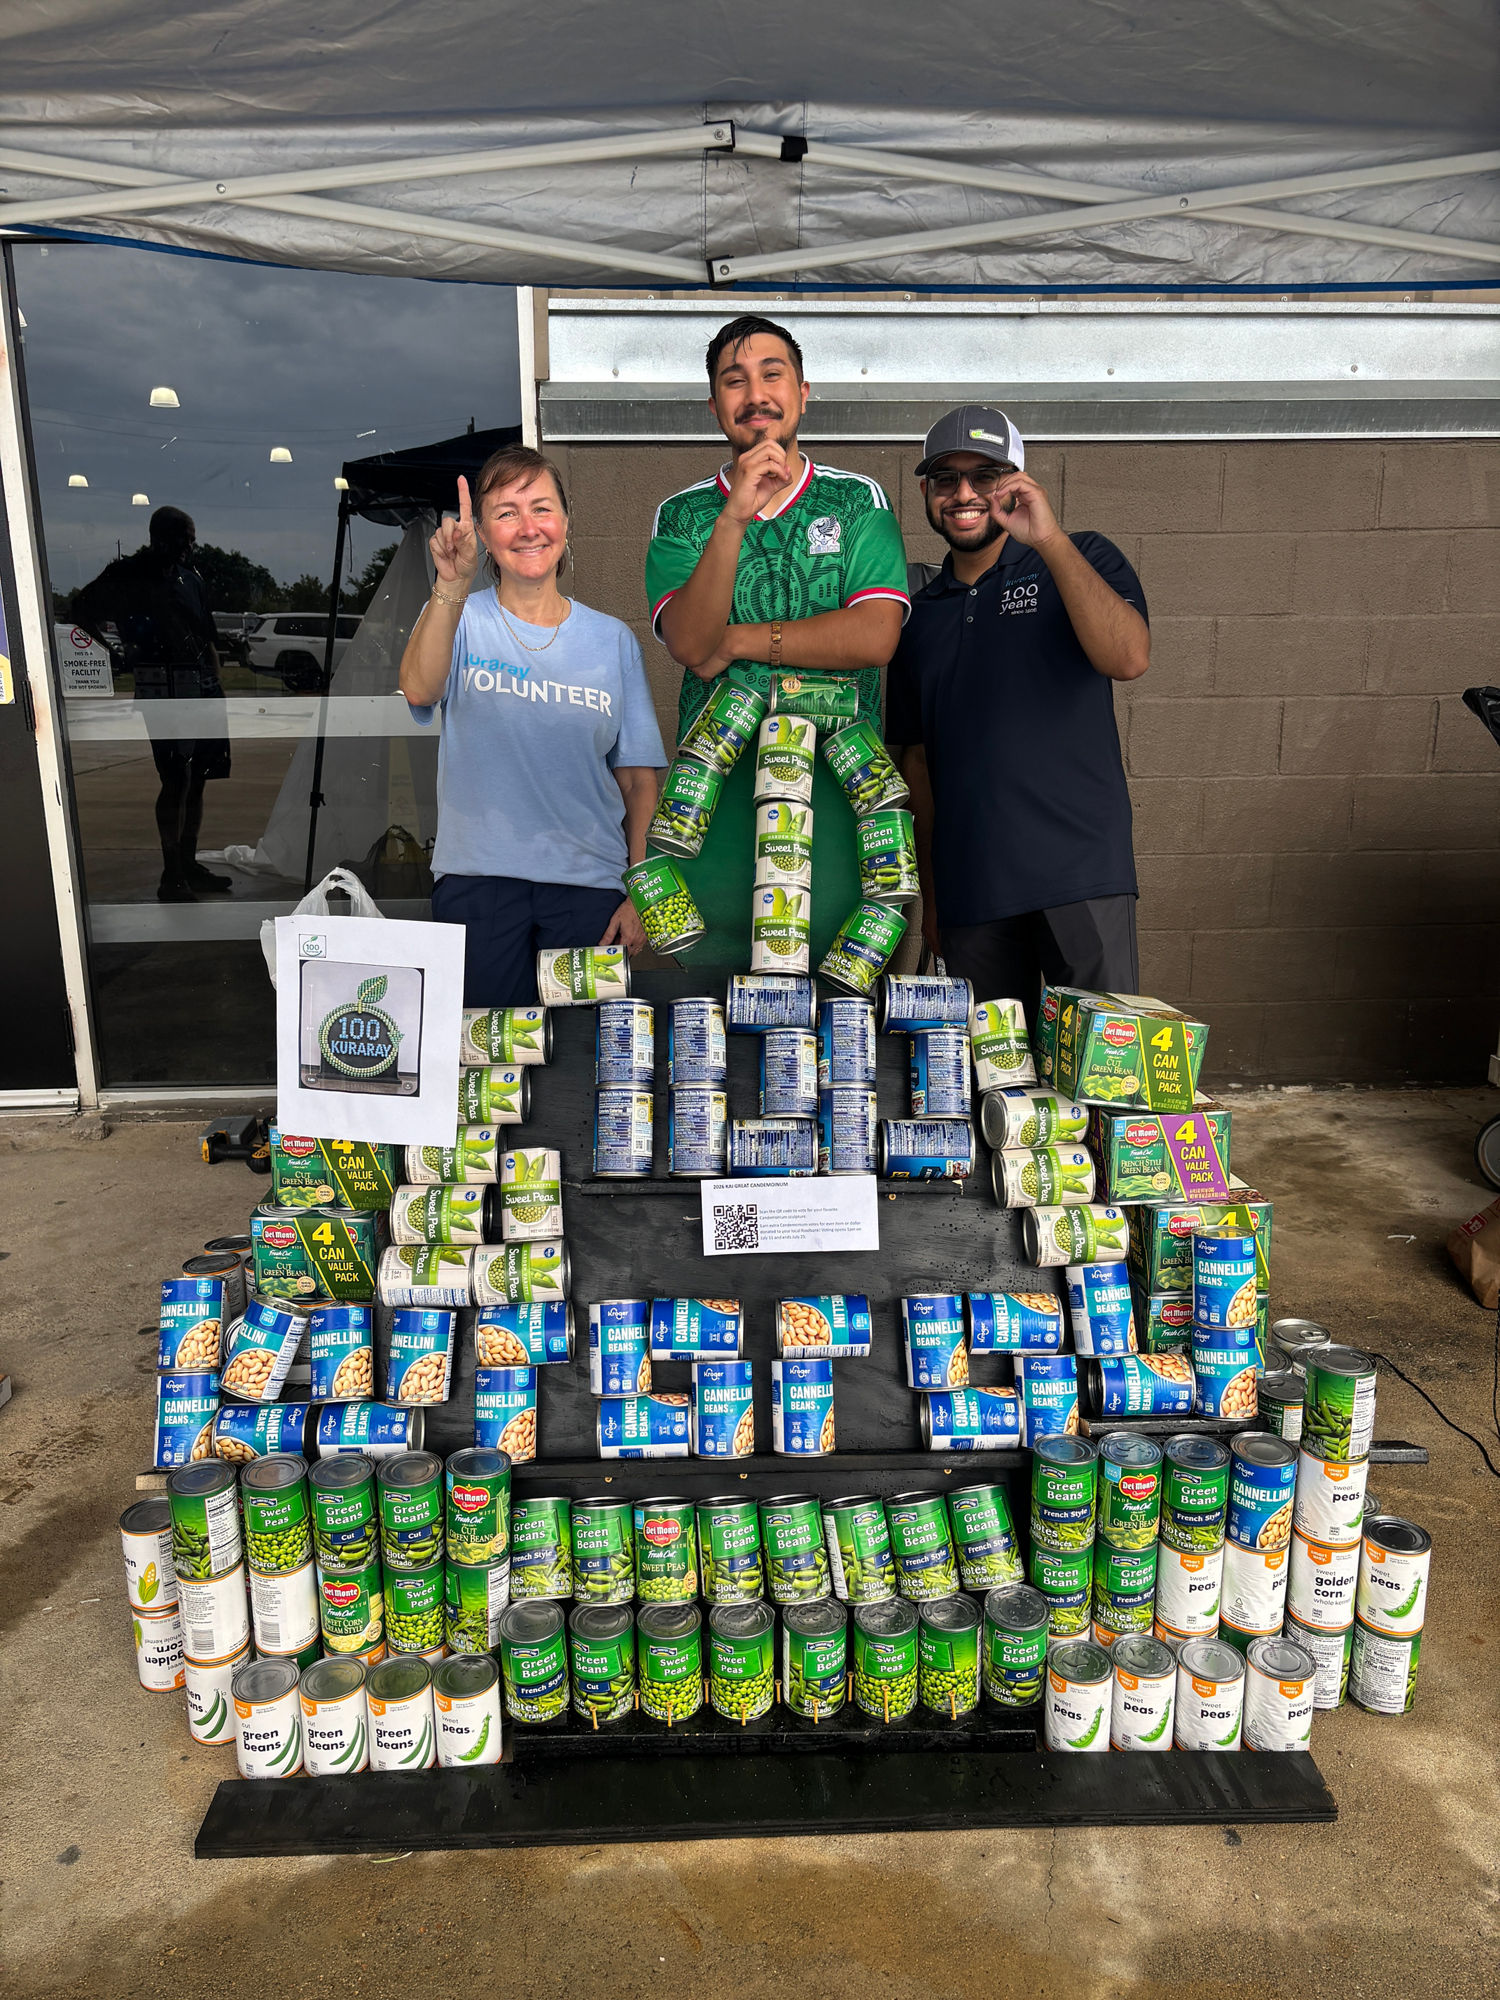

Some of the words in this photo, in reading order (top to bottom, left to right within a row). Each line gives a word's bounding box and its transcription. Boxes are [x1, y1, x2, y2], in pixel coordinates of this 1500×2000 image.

[1001, 583, 1038, 602] 100
[999, 598, 1037, 615] years
[463, 668, 612, 717] VOLUNTEER
[731, 703, 756, 724] Green
[726, 710, 752, 732] Beans
[697, 736, 715, 749] Ejote
[727, 732, 737, 740] Cut
[693, 743, 715, 758] Cortado
[833, 745, 856, 768] Green
[764, 755, 790, 764] Sweet
[791, 756, 809, 769] Peas
[837, 752, 861, 777] Beans
[678, 777, 708, 792] Green
[675, 786, 706, 800] Beans
[863, 827, 893, 842] Green
[863, 837, 894, 851] Beans
[638, 875, 662, 893] Sweet
[644, 887, 663, 901] Peas
[760, 927, 787, 937] Sweet
[789, 928, 806, 939] Peas
[863, 919, 893, 937] Green
[858, 927, 888, 945] Beans
[573, 948, 583, 968] Sweet
[847, 942, 869, 954] French
[870, 950, 883, 962] Style
[574, 970, 584, 993] Peas
[339, 1017, 380, 1040] 100
[491, 1011, 503, 1033] Sweet
[1116, 1029, 1135, 1037] Monte
[1151, 1027, 1173, 1052] 4
[330, 1040, 392, 1057] KURARAY
[492, 1034, 501, 1058] Peas
[981, 1043, 1007, 1055] Sweet
[1153, 1054, 1178, 1069] CAN
[1092, 1064, 1113, 1073] GREEN
[1114, 1066, 1133, 1075] BEANS
[1155, 1070, 1180, 1080] VALUE
[1158, 1082, 1182, 1094] PACK
[1127, 1130, 1137, 1138] Del
[1175, 1120, 1198, 1144] 4
[1181, 1146, 1205, 1160] CAN
[339, 1157, 364, 1169] CAN
[1185, 1161, 1210, 1170] VALUE
[347, 1171, 373, 1180] VALUE
[1121, 1166, 1141, 1174] GREEN
[1190, 1172, 1214, 1182] PACK
[354, 1182, 379, 1191] PACK
[506, 1194, 532, 1204] Sweet
[533, 1192, 554, 1202] Peas
[1069, 1210, 1081, 1233] Sweet
[312, 1222, 335, 1244] 4
[1074, 1235, 1085, 1258] Peas
[319, 1248, 345, 1260] CAN
[328, 1263, 354, 1271] VALUE
[1199, 1261, 1253, 1276] CANNELLINI
[335, 1273, 359, 1282] PACK
[1092, 1270, 1113, 1281] Kroger
[1199, 1275, 1222, 1286] BEANS
[608, 1308, 628, 1319] Kroger
[913, 1303, 934, 1314] Kroger
[608, 1342, 633, 1351] BEANS
[916, 1337, 940, 1346] BEANS
[1195, 1352, 1248, 1365] CANNELLINI
[166, 1381, 186, 1393] Kroger
[164, 1415, 188, 1424] BEANS
[1048, 1482, 1083, 1491] Green
[1234, 1480, 1290, 1502] CANNELLINI
[454, 1492, 465, 1500] Del
[468, 1493, 487, 1501] Monte
[1048, 1491, 1083, 1501] Beans
[1233, 1495, 1256, 1510] BEANS
[1332, 1493, 1359, 1503] peas
[260, 1505, 291, 1517] Sweet
[325, 1502, 362, 1516] Green
[1044, 1509, 1068, 1518] French
[1071, 1508, 1087, 1518] Style
[264, 1517, 289, 1527] Peas
[327, 1511, 363, 1524] Beans
[461, 1526, 477, 1535] CUT
[776, 1524, 810, 1538] Green
[778, 1535, 811, 1549] Beans
[642, 1562, 665, 1572] SWEET
[667, 1562, 685, 1571] PEAS
[1315, 1576, 1354, 1587] golden
[1371, 1574, 1400, 1590] peas
[1315, 1588, 1343, 1598] corn
[521, 1652, 556, 1669] Green
[718, 1654, 746, 1664] Sweet
[522, 1661, 557, 1678] Beans
[721, 1665, 743, 1674] Peas
[1201, 1709, 1231, 1719] peas
[243, 1729, 278, 1740] green
[442, 1723, 470, 1735] peas
[244, 1739, 281, 1752] beans
